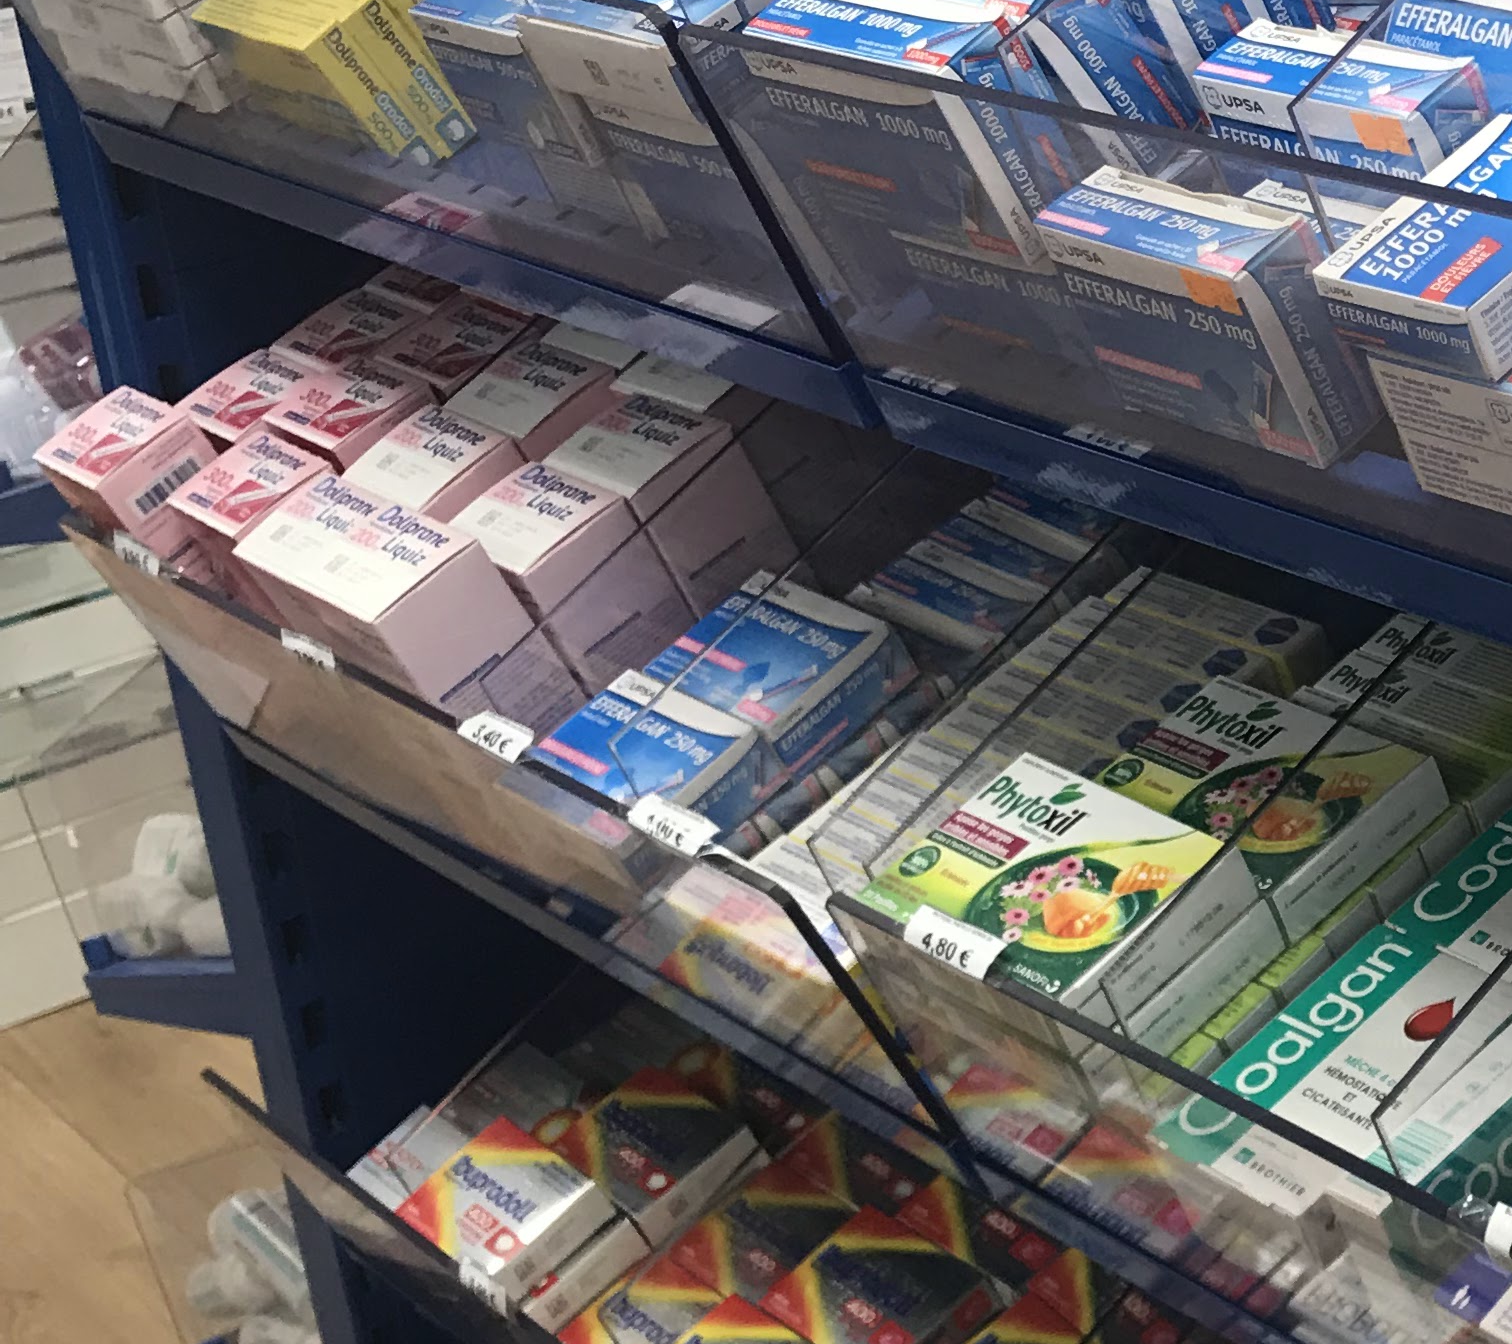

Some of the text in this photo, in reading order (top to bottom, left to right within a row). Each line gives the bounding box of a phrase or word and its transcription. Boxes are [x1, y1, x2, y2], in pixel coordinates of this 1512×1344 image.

[766, 87, 951, 151] EFFERALGAN 1000 mg
[1220, 93, 1266, 116] UPSA
[1349, 216, 1396, 252] UPSA
[1430, 243, 1486, 291] DOULEURS
[1441, 251, 1491, 294] ET FIÈVRE
[1066, 273, 1257, 349] EFFERALGAN 250 mg
[1328, 304, 1470, 352] EFFERALGAN 1000 mg
[419, 407, 486, 446] Doliprane
[422, 437, 464, 463] Liquiz
[519, 464, 597, 506] Doliprane
[376, 506, 450, 548] Doliprane
[526, 494, 574, 522] Liquiz
[381, 536, 426, 567] Liquiz
[1175, 691, 1288, 750] Phytoxil
[977, 776, 1087, 836] Phytoxil
[922, 932, 974, 968] 4,80 €
[1301, 1088, 1373, 1131] CICATRISANTE
